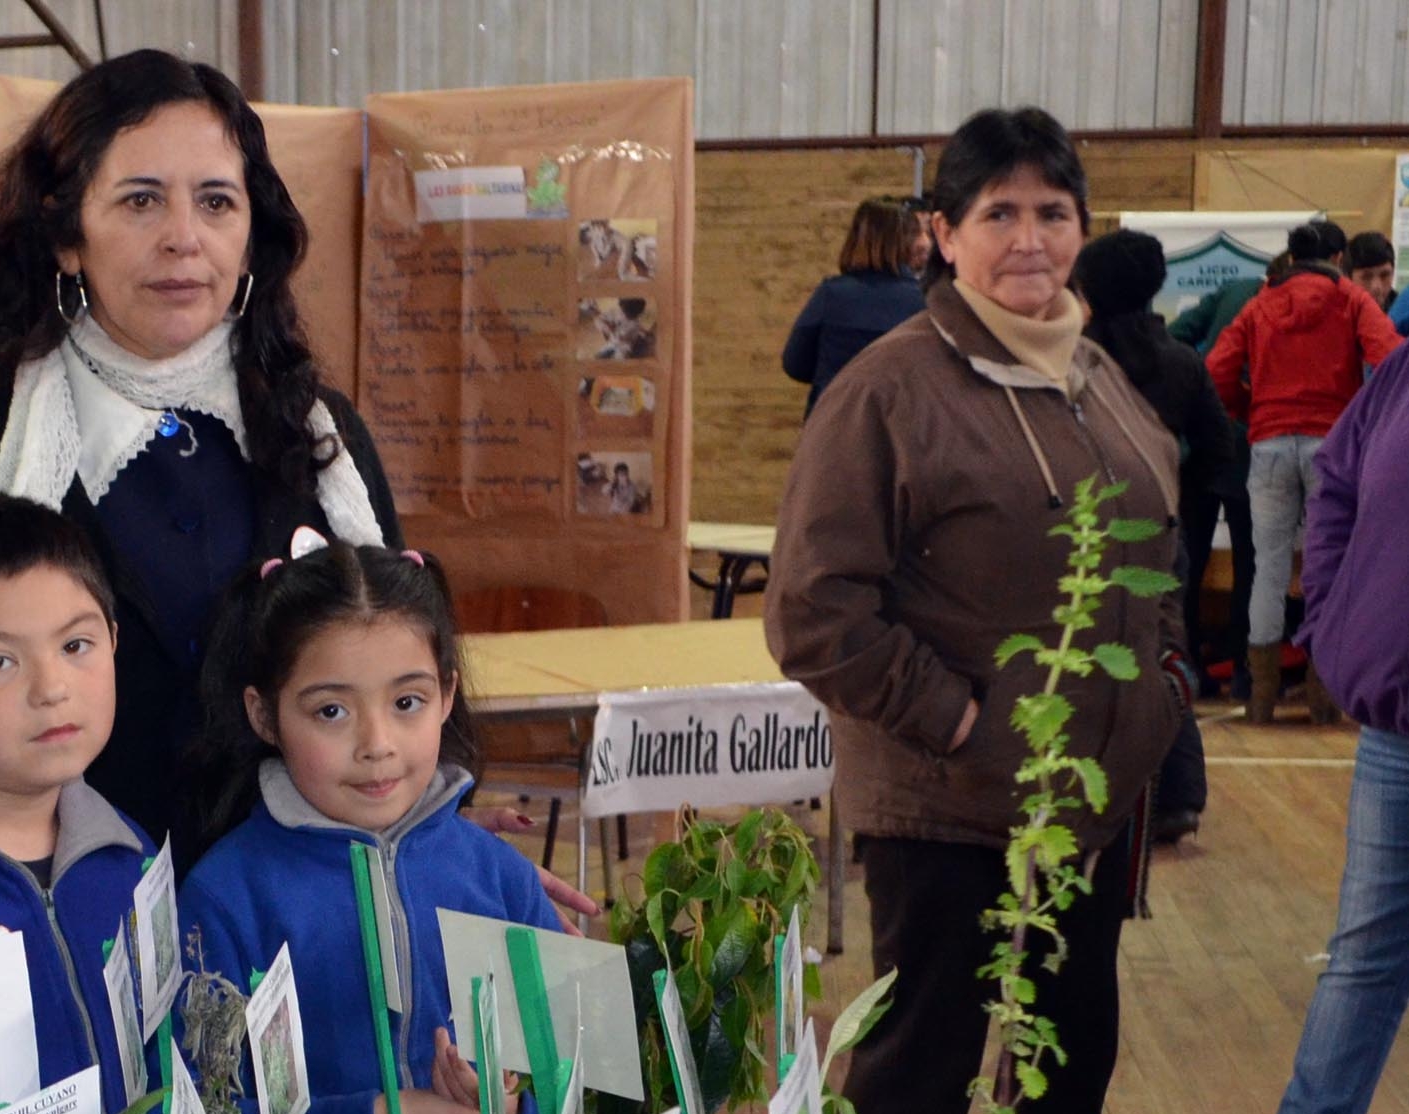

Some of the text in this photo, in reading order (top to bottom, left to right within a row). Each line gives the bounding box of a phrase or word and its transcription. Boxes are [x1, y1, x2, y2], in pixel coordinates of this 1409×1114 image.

[627, 714, 719, 778] Juanita
[729, 709, 833, 774] Gallardo
[34, 1083, 78, 1114] CUYANO
